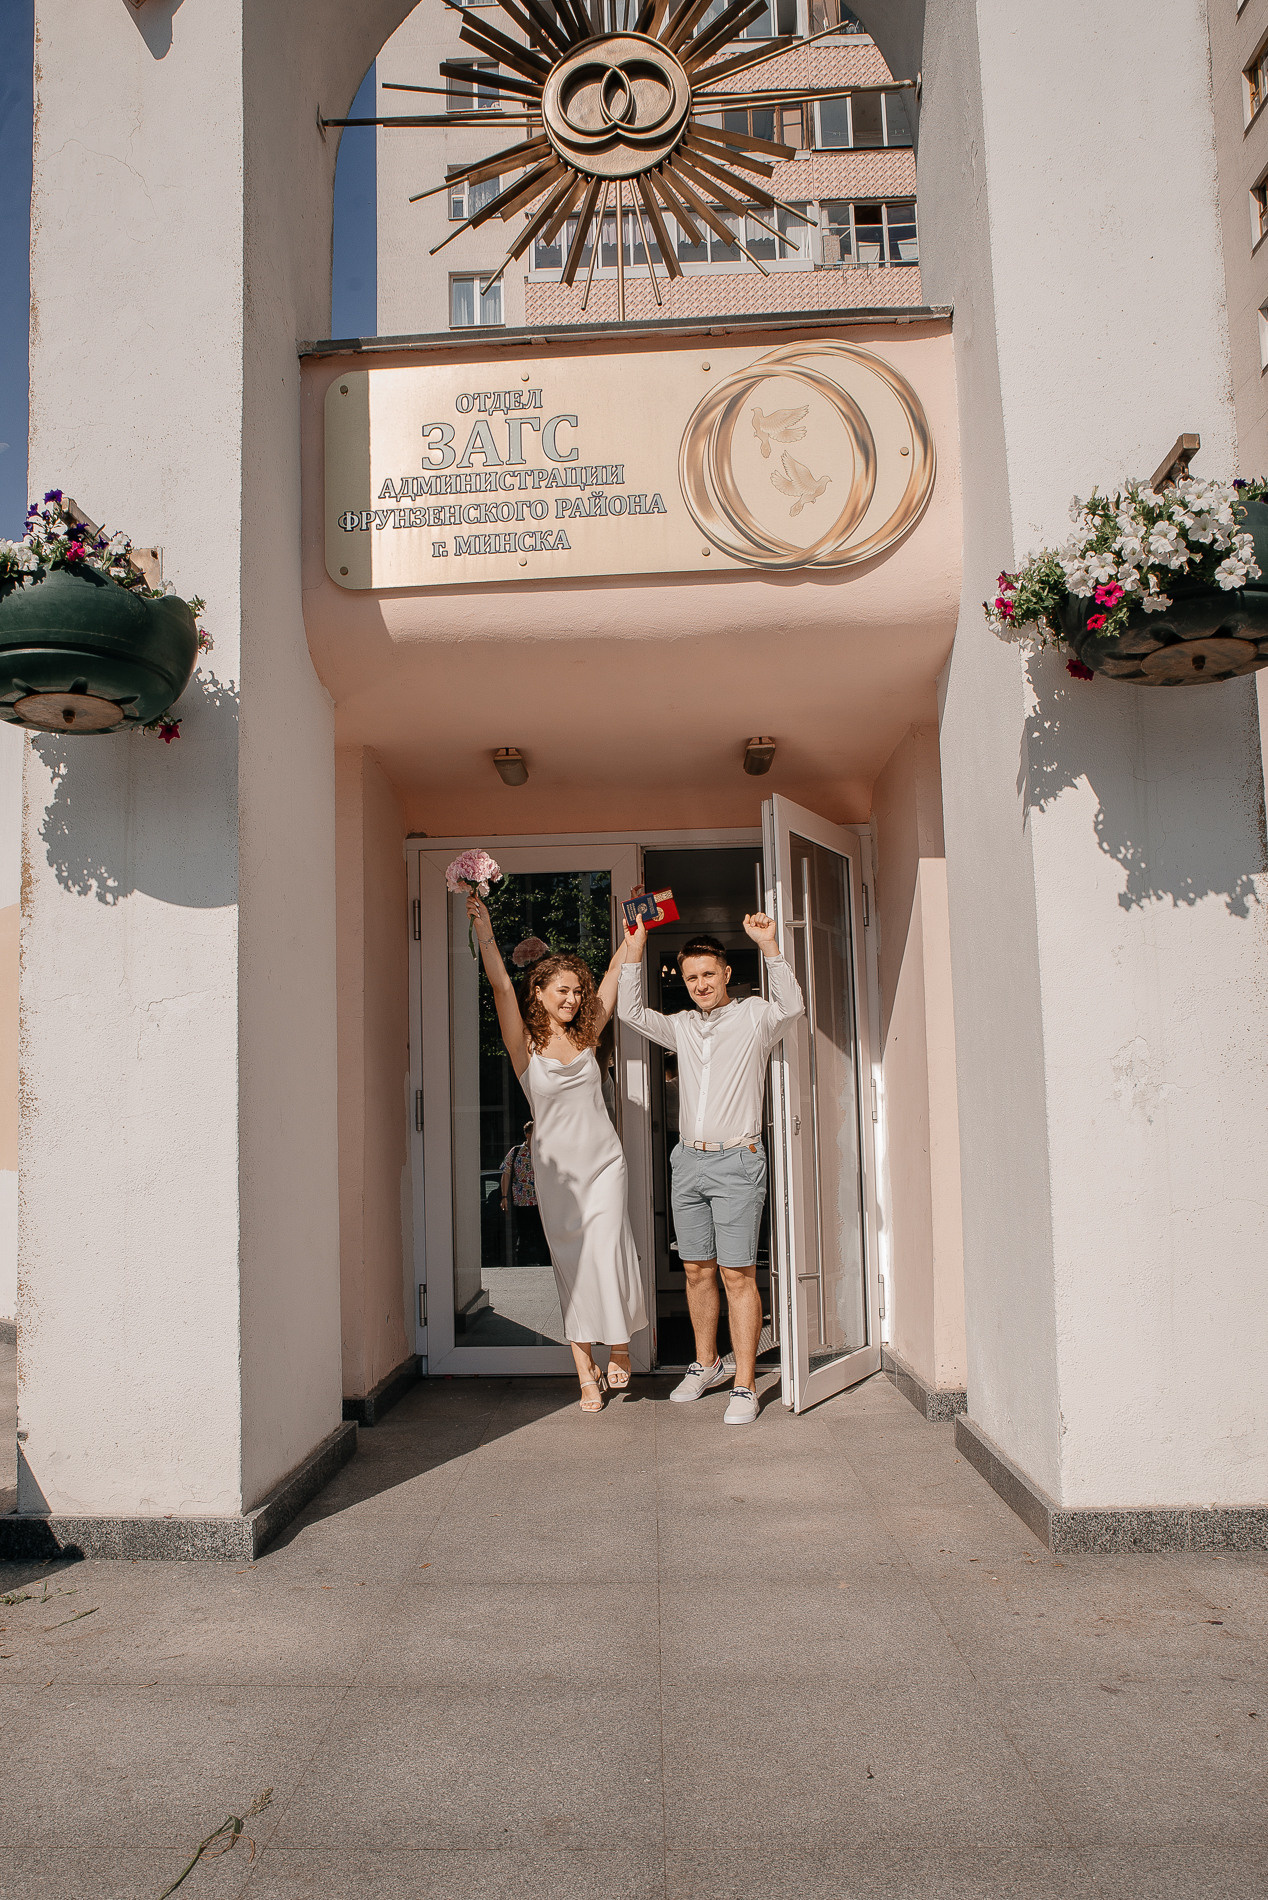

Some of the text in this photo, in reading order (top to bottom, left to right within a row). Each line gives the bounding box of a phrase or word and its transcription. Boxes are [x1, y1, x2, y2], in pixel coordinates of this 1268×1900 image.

[455, 388, 543, 416] ОТДЕЛ
[421, 414, 579, 470] ЗАГС
[378, 464, 625, 502] АДМИНИСТРАЦИИ
[337, 491, 667, 532] ФРУНЗЕНСКОГО РАЙОНА
[453, 529, 571, 557] МИНСКА
